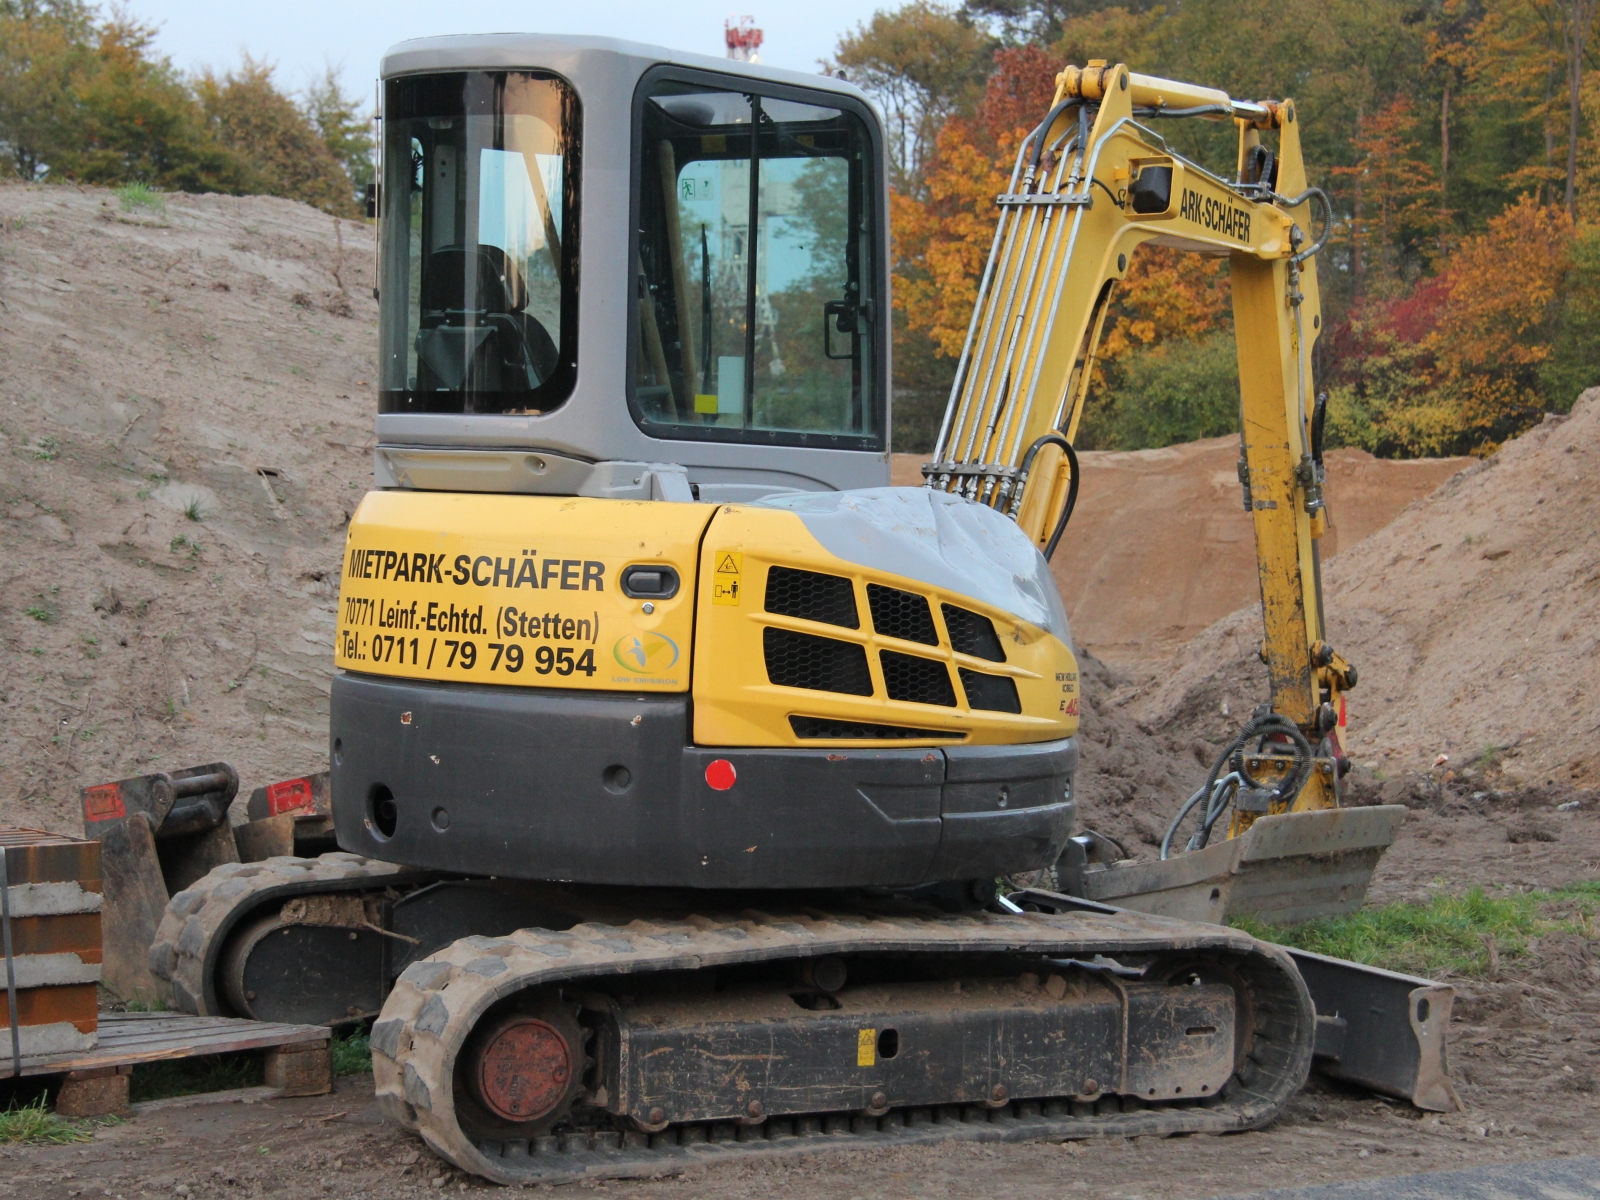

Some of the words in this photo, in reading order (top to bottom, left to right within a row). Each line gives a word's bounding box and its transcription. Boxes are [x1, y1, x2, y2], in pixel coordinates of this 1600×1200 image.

[348, 549, 606, 591] MIETPARK-SCHÄFER
[345, 597, 375, 626] 70771
[379, 599, 487, 635] Leinf.-Echtd.
[497, 606, 599, 644] (Stetten)
[343, 630, 366, 660] Tel.:
[372, 634, 419, 665] 0711
[426, 638, 437, 669] /
[445, 640, 477, 670] 79
[488, 643, 524, 673] 79
[535, 646, 597, 677] 954
[634, 677, 678, 685] EMISSION
